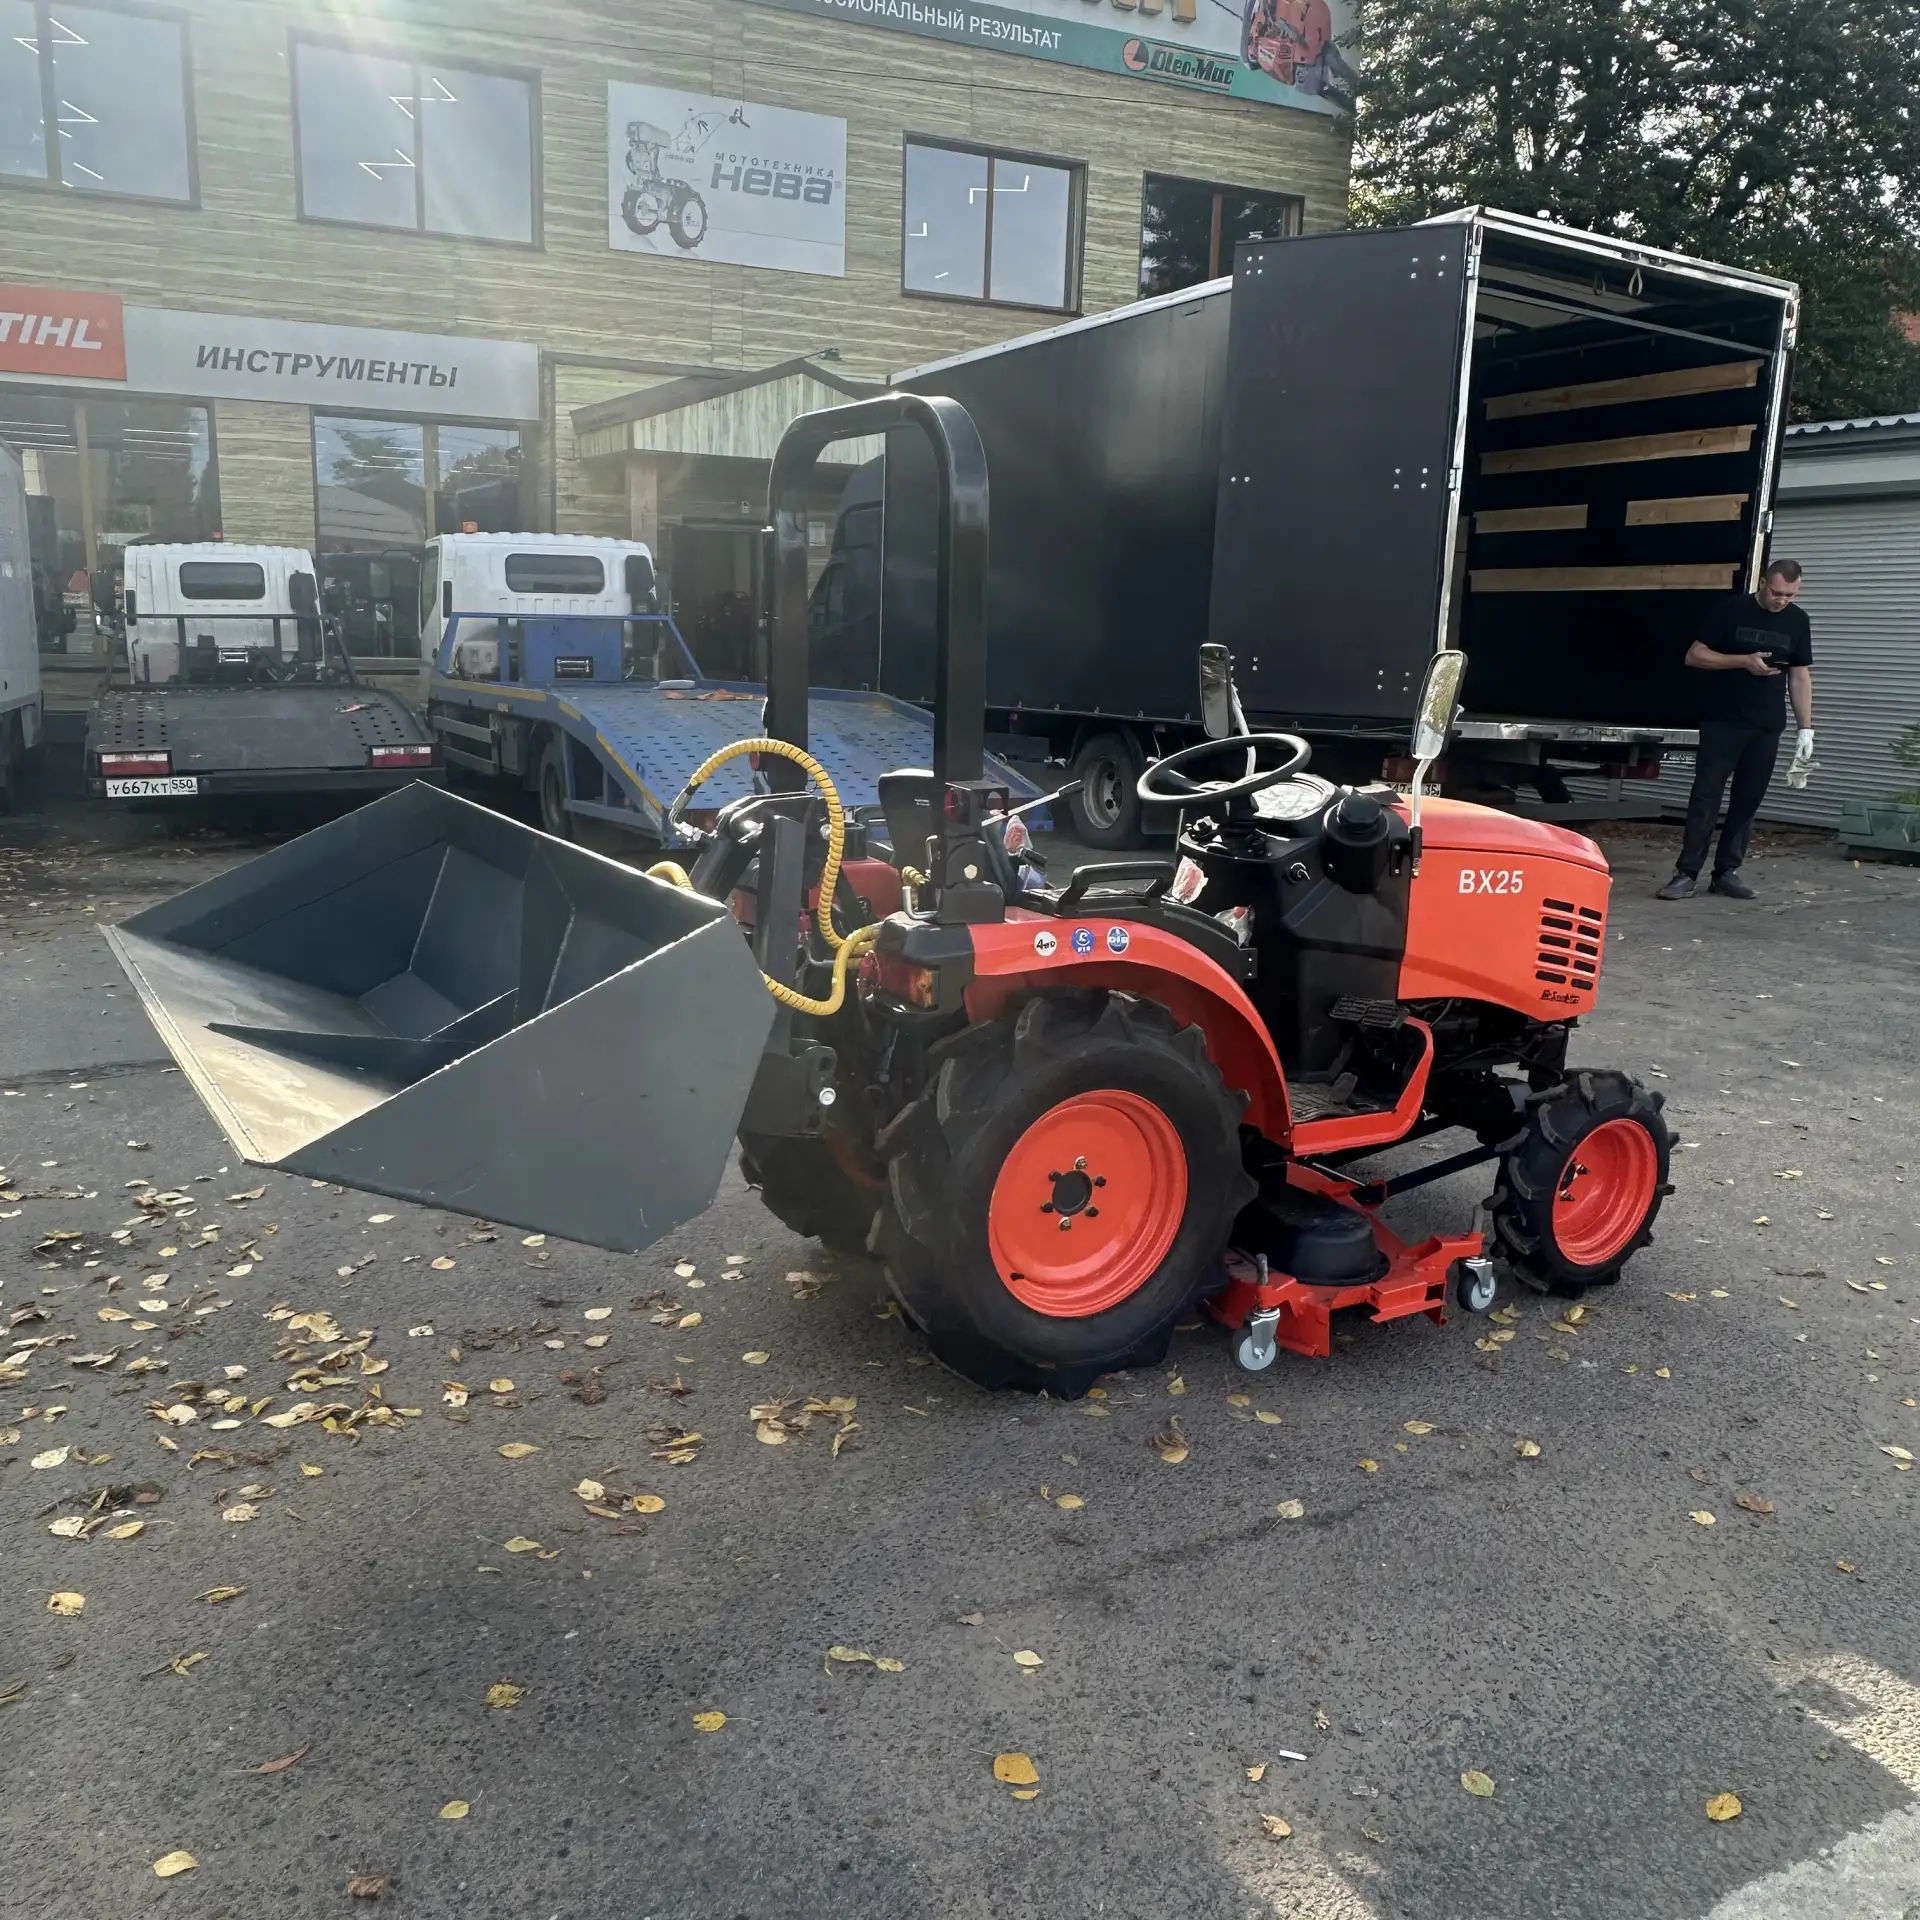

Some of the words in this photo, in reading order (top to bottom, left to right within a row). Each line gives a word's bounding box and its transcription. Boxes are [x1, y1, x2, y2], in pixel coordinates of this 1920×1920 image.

[969, 16, 1062, 49] РЕЗУЛЬТАТ
[1150, 49, 1235, 85] Oleo-Mac
[715, 151, 834, 179] МОТОТЕХНИКА
[195, 344, 458, 388] ИНСТРУМЕНТЫ
[171, 779, 194, 789] 550
[1458, 868, 1525, 895] BX25
